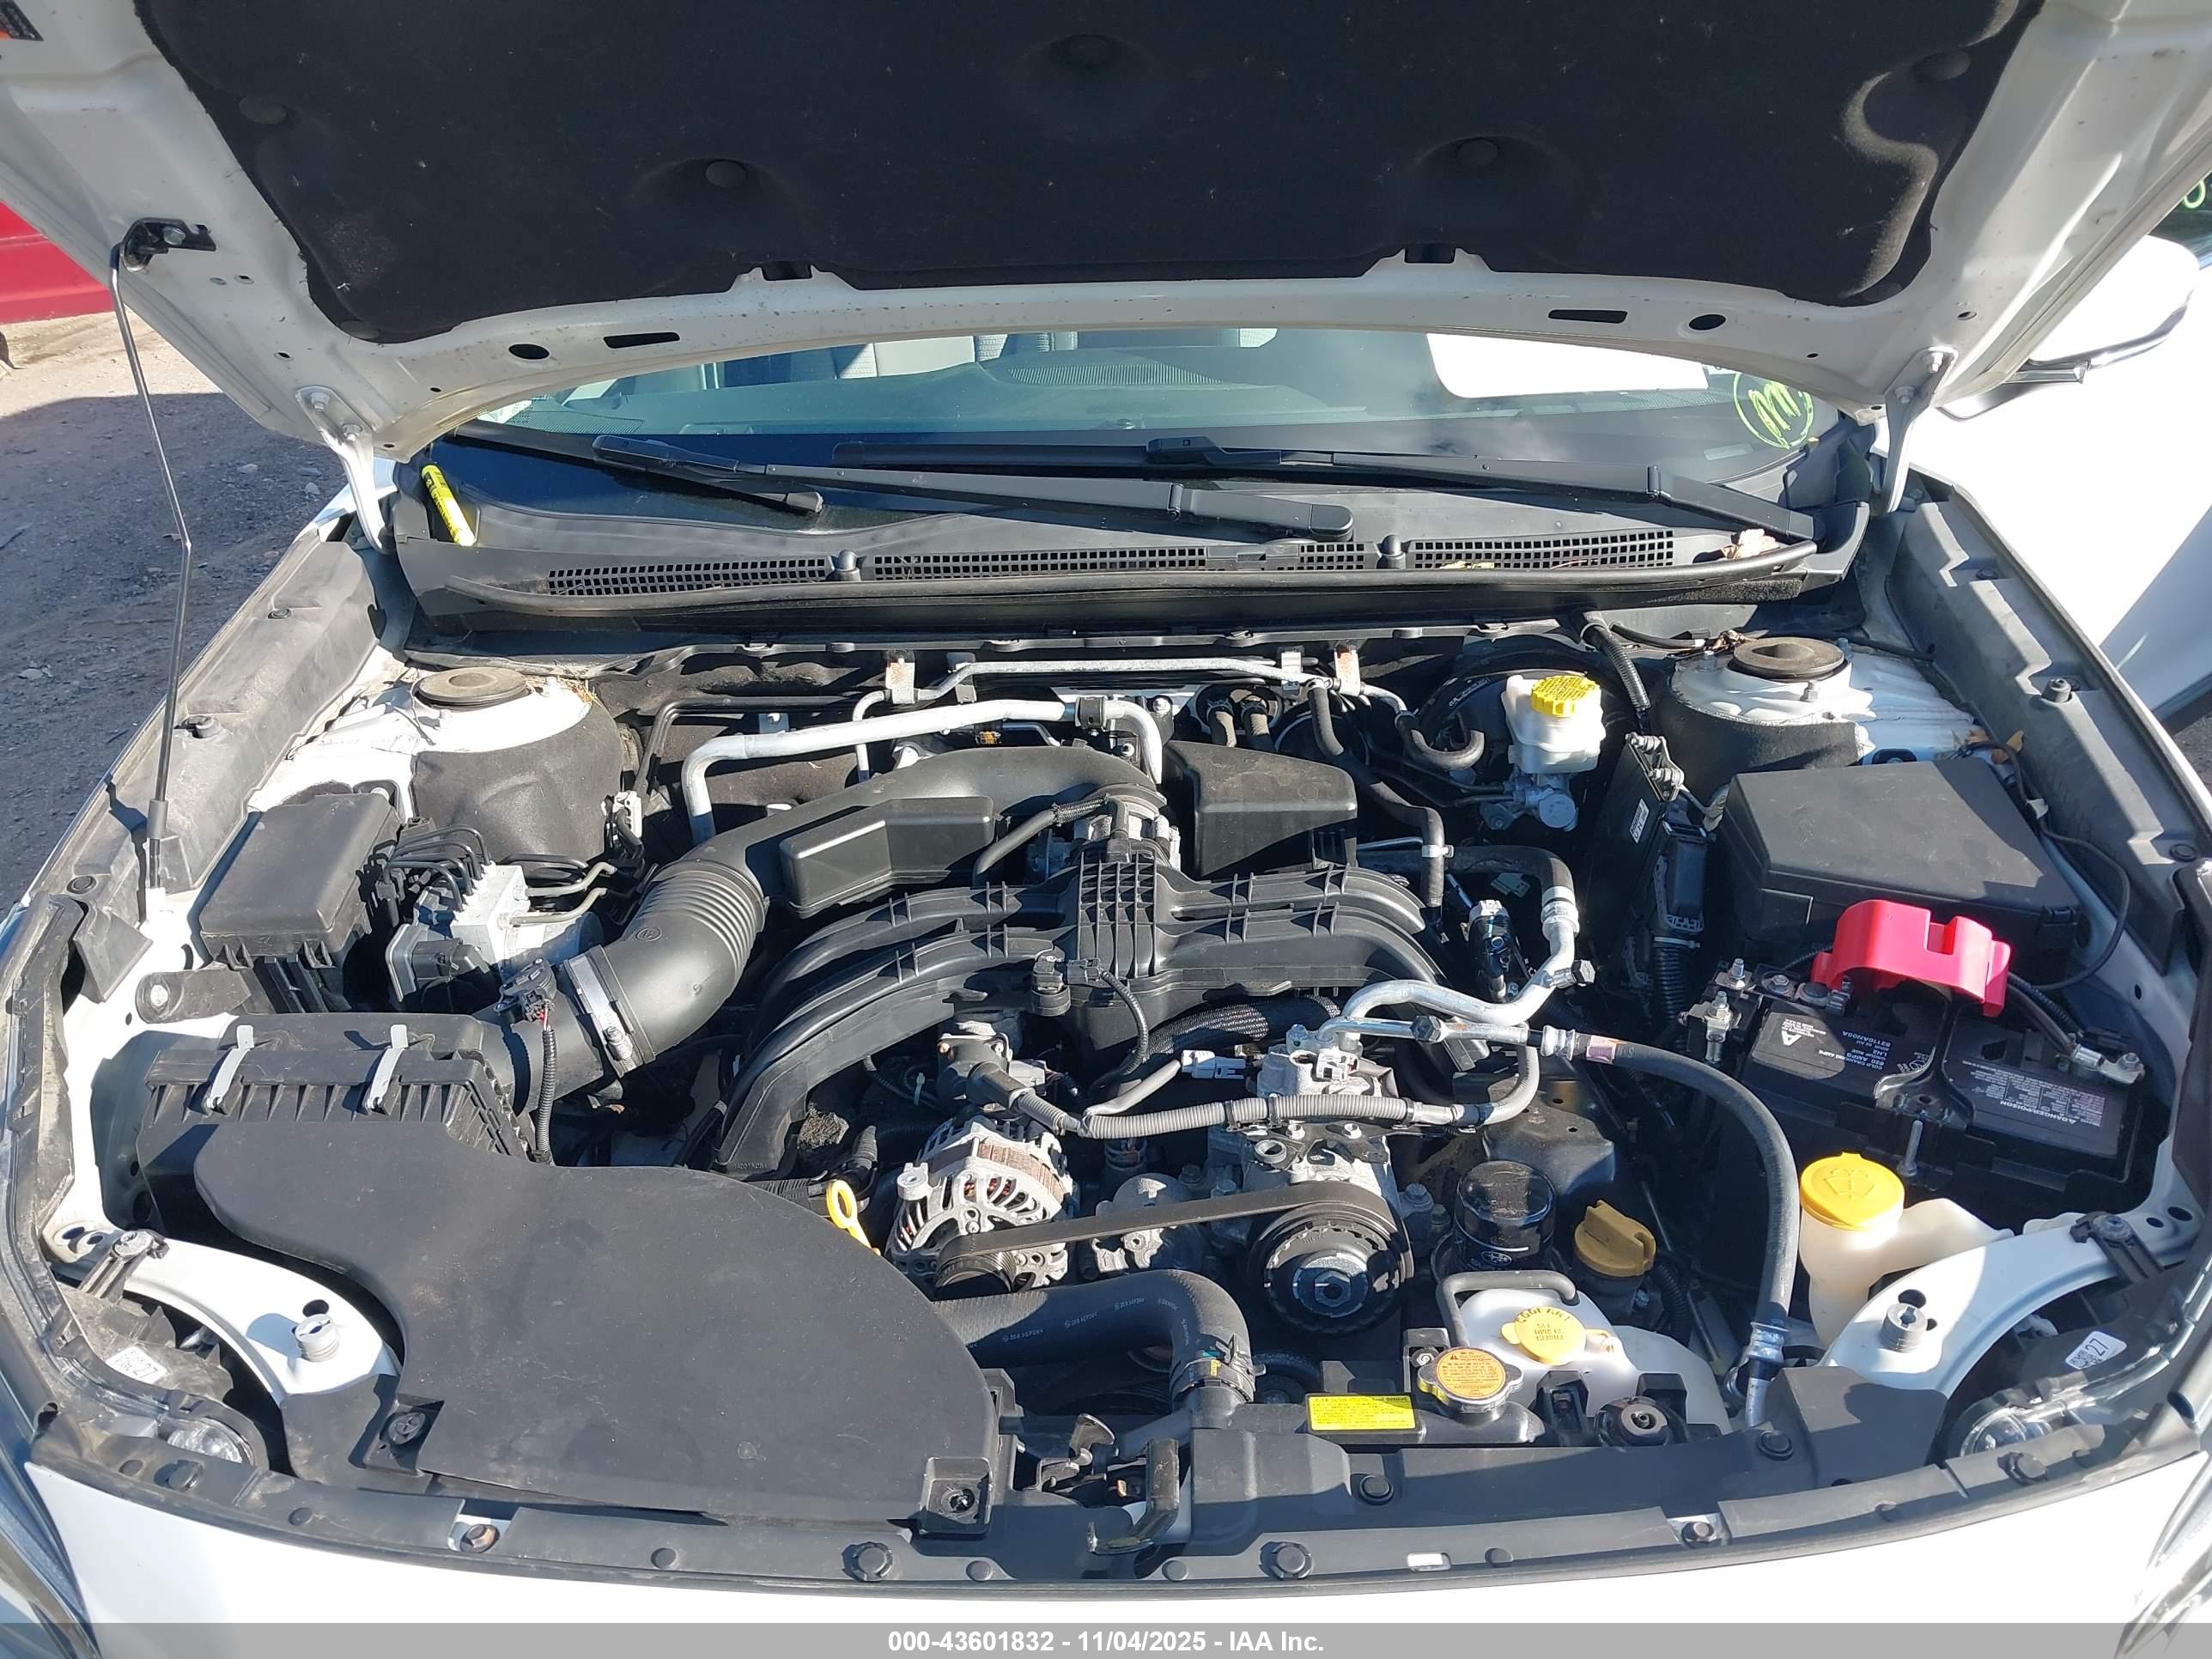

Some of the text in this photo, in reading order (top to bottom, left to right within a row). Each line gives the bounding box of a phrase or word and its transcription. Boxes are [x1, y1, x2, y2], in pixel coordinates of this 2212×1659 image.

[1781, 1030, 1802, 1047] A
[1818, 1049, 1835, 1058] AMPS
[1835, 1054, 1866, 1066] CRANKING
[1846, 1052, 1869, 1061] AMPS
[1999, 1100, 2069, 1122] DANGER/POISON
[2085, 1338, 2109, 1357] 27
[132, 1363, 159, 1379] 27
